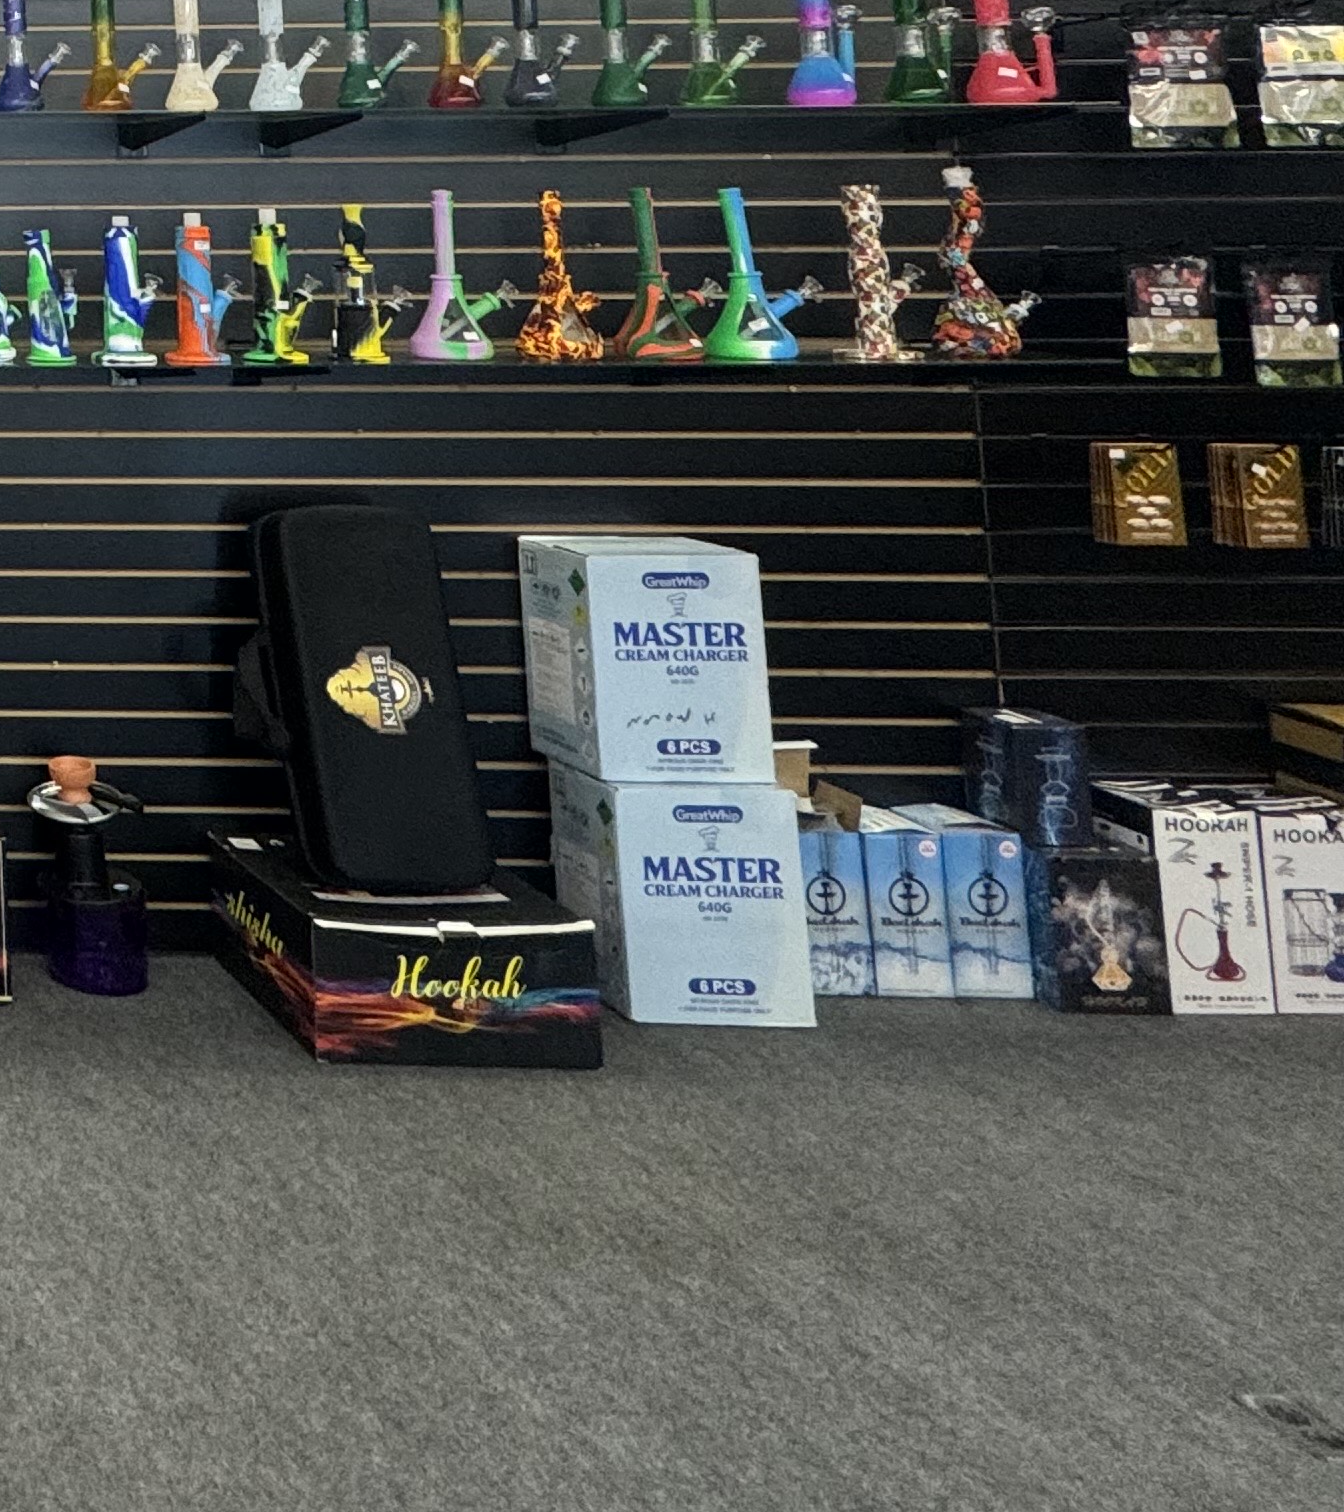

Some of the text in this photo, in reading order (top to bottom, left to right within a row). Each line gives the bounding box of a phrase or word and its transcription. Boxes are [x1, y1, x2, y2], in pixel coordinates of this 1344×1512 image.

[644, 575, 708, 589] GreatWhip
[613, 621, 748, 648] MASTER
[614, 648, 749, 663] CREAM CHARGER
[666, 665, 700, 676] 640G
[371, 654, 399, 726] KHATEEB
[666, 740, 712, 754] 6 PCS
[675, 808, 741, 823] GreatWhip
[1164, 817, 1248, 832] HOOKAH
[1273, 828, 1344, 844] HOOKA
[643, 855, 783, 885] MASTER
[644, 883, 785, 900] CREAM CHARGER
[698, 901, 733, 914] 640G
[390, 954, 528, 1004] Hookah
[698, 979, 746, 995] 6 PCS
